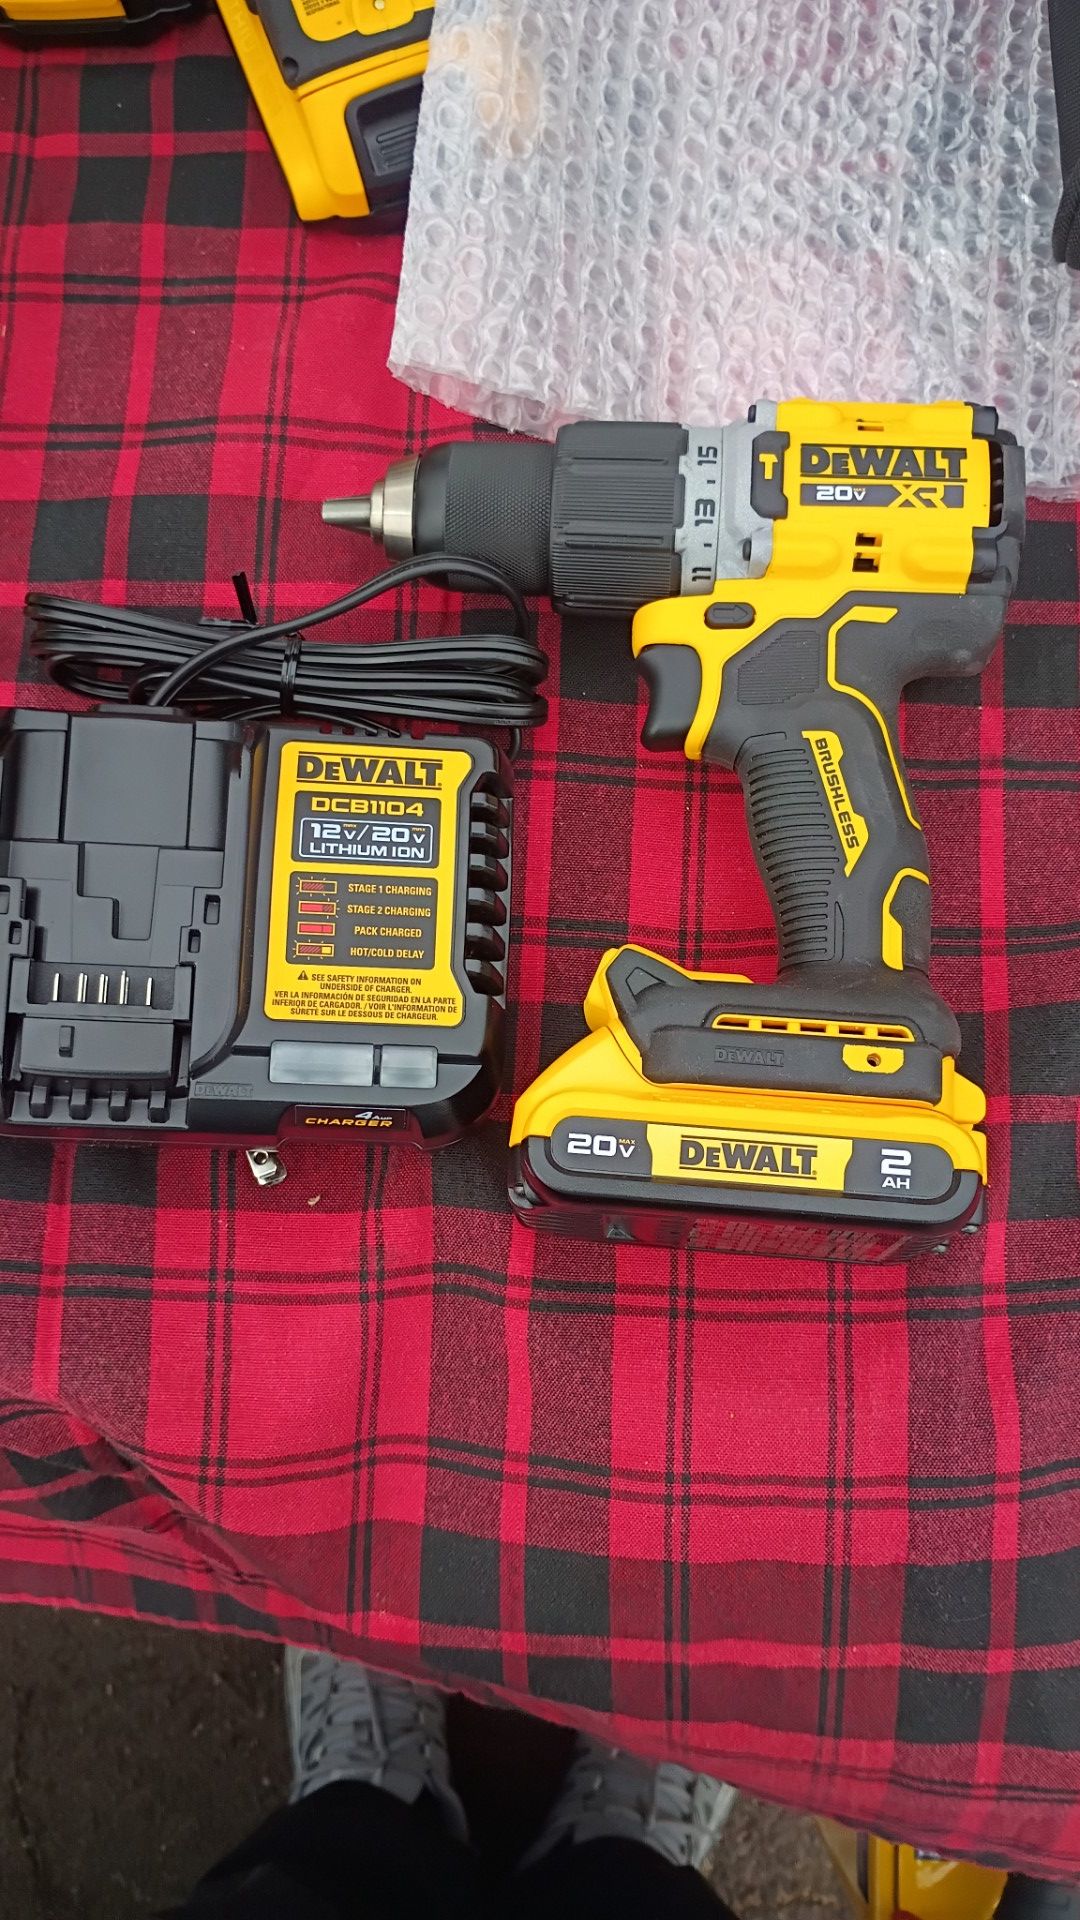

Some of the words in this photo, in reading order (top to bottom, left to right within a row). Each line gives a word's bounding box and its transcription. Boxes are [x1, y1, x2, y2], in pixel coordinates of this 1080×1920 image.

[697, 446, 718, 466] 15
[801, 447, 967, 478] DEWALT
[888, 484, 949, 508] XR
[694, 498, 715, 527] 13
[691, 567, 711, 582] 11
[297, 755, 443, 787] DEWALT
[815, 737, 860, 849] BRUSHLESS
[311, 796, 424, 817] DCB1104
[310, 842, 387, 858] LITHIUM
[392, 846, 425, 859] ION
[348, 883, 377, 894] STAGE
[379, 885, 384, 894] 1
[385, 886, 432, 896] CHARGING
[347, 904, 376, 915] STAGE
[378, 906, 383, 915] 2
[385, 907, 431, 917] CHARGING
[354, 925, 378, 936] PACK
[380, 928, 422, 938] CHARGED
[350, 947, 394, 957] HOT/COLD
[396, 949, 424, 959] DELAY
[327, 974, 355, 982] SAFETY
[357, 976, 409, 985] INFORMATION
[320, 983, 363, 991] UNDERSIDE
[375, 985, 412, 993] CHARGER.
[301, 992, 353, 1000] INFORMACIÓN
[367, 995, 409, 1003] SEGURIDAD
[272, 999, 306, 1007] INFERIOR
[319, 1001, 362, 1009] CARGADOR.
[388, 1003, 446, 1012] L'INFORMATION
[348, 1010, 383, 1018] DESSOUS
[396, 1012, 438, 1020] CHARGEUR.
[714, 1047, 784, 1066] DEWALT
[305, 1118, 393, 1127] CHARGER
[355, 1111, 373, 1120] 4
[567, 1133, 635, 1158] 20V
[680, 1140, 818, 1175] DEWALT
[880, 1148, 912, 1177] 2
[881, 1177, 911, 1190] AH
